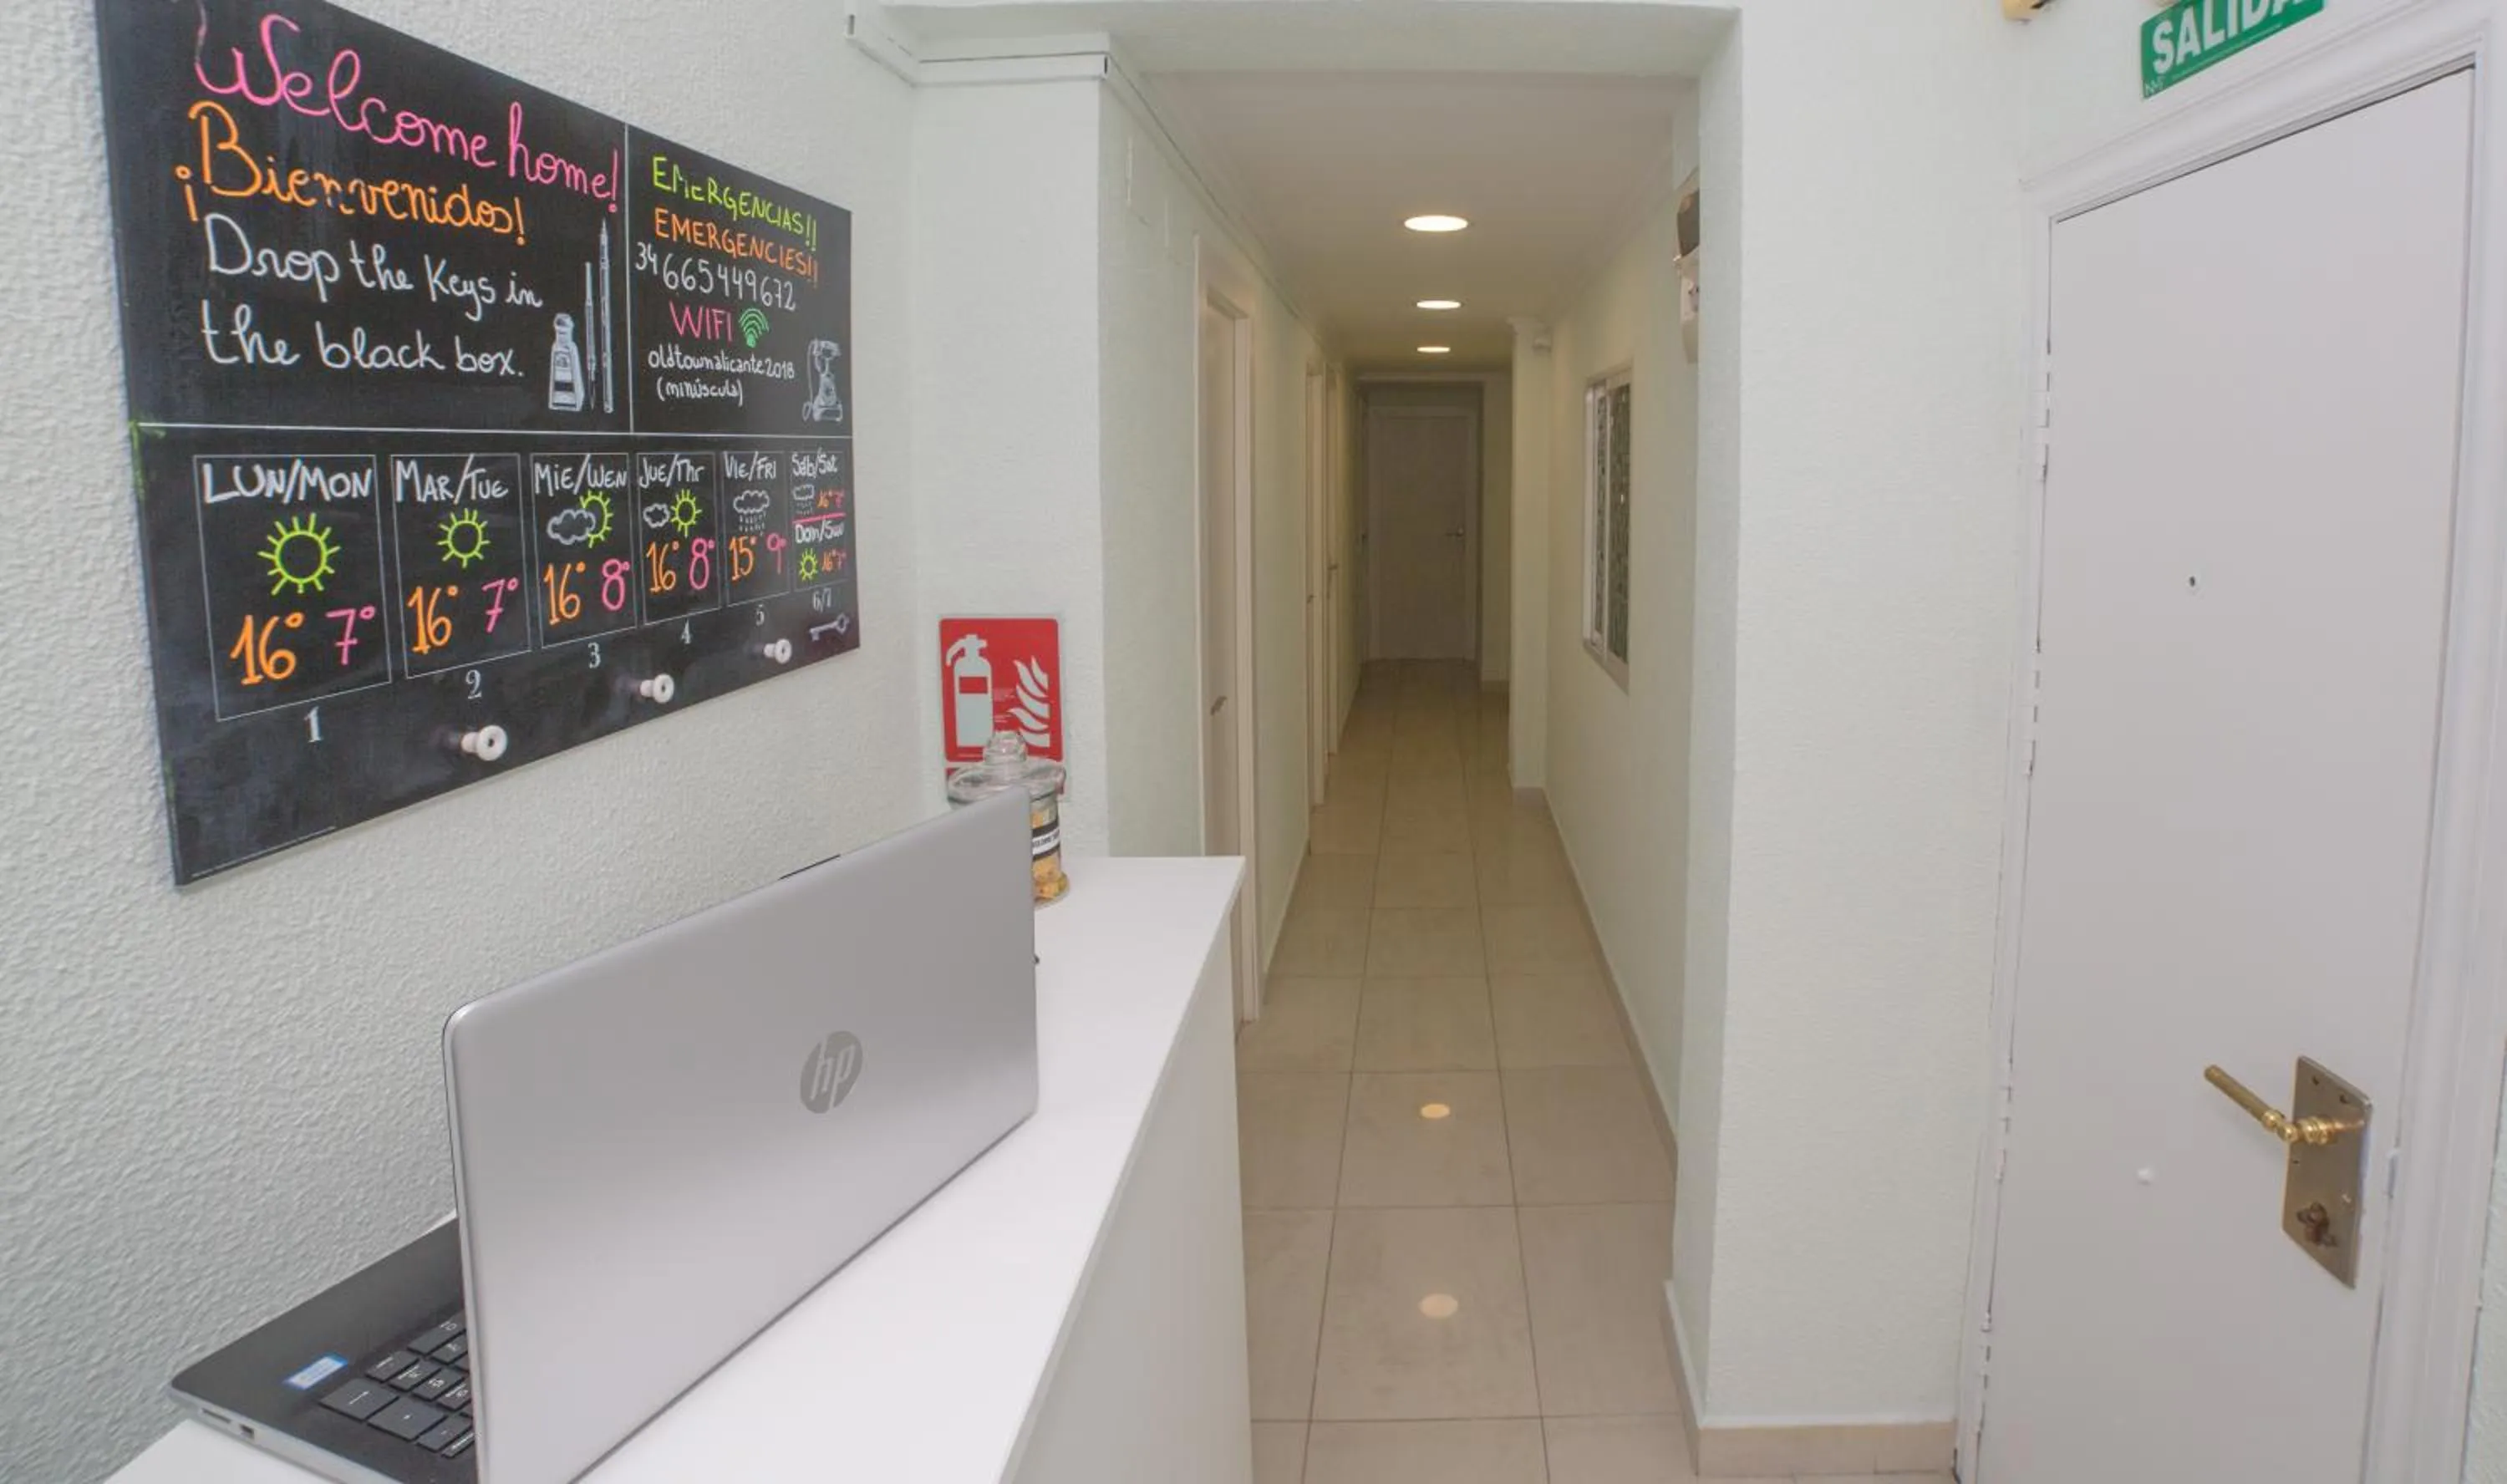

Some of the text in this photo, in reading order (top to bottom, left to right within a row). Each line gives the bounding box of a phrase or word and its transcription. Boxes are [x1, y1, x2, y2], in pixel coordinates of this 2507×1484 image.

[2153, 0, 2303, 74] SALID
[194, 0, 620, 213] Welcome home!
[203, 212, 341, 302] Drop
[349, 241, 414, 292] the
[507, 272, 543, 308] in
[655, 206, 819, 288] EMERGENCIES!!
[201, 299, 525, 377] the black box.
[669, 299, 733, 343] WIFI
[202, 459, 374, 504] LUN/MON
[407, 577, 519, 654] 16° 7°
[543, 561, 586, 625] 16°
[755, 604, 765, 625] 5
[230, 606, 376, 685] 16° 7°
[587, 642, 601, 668] 3
[681, 618, 692, 644] 4
[465, 669, 482, 699] 2
[303, 706, 323, 743] 1
[803, 1031, 861, 1112] hp
